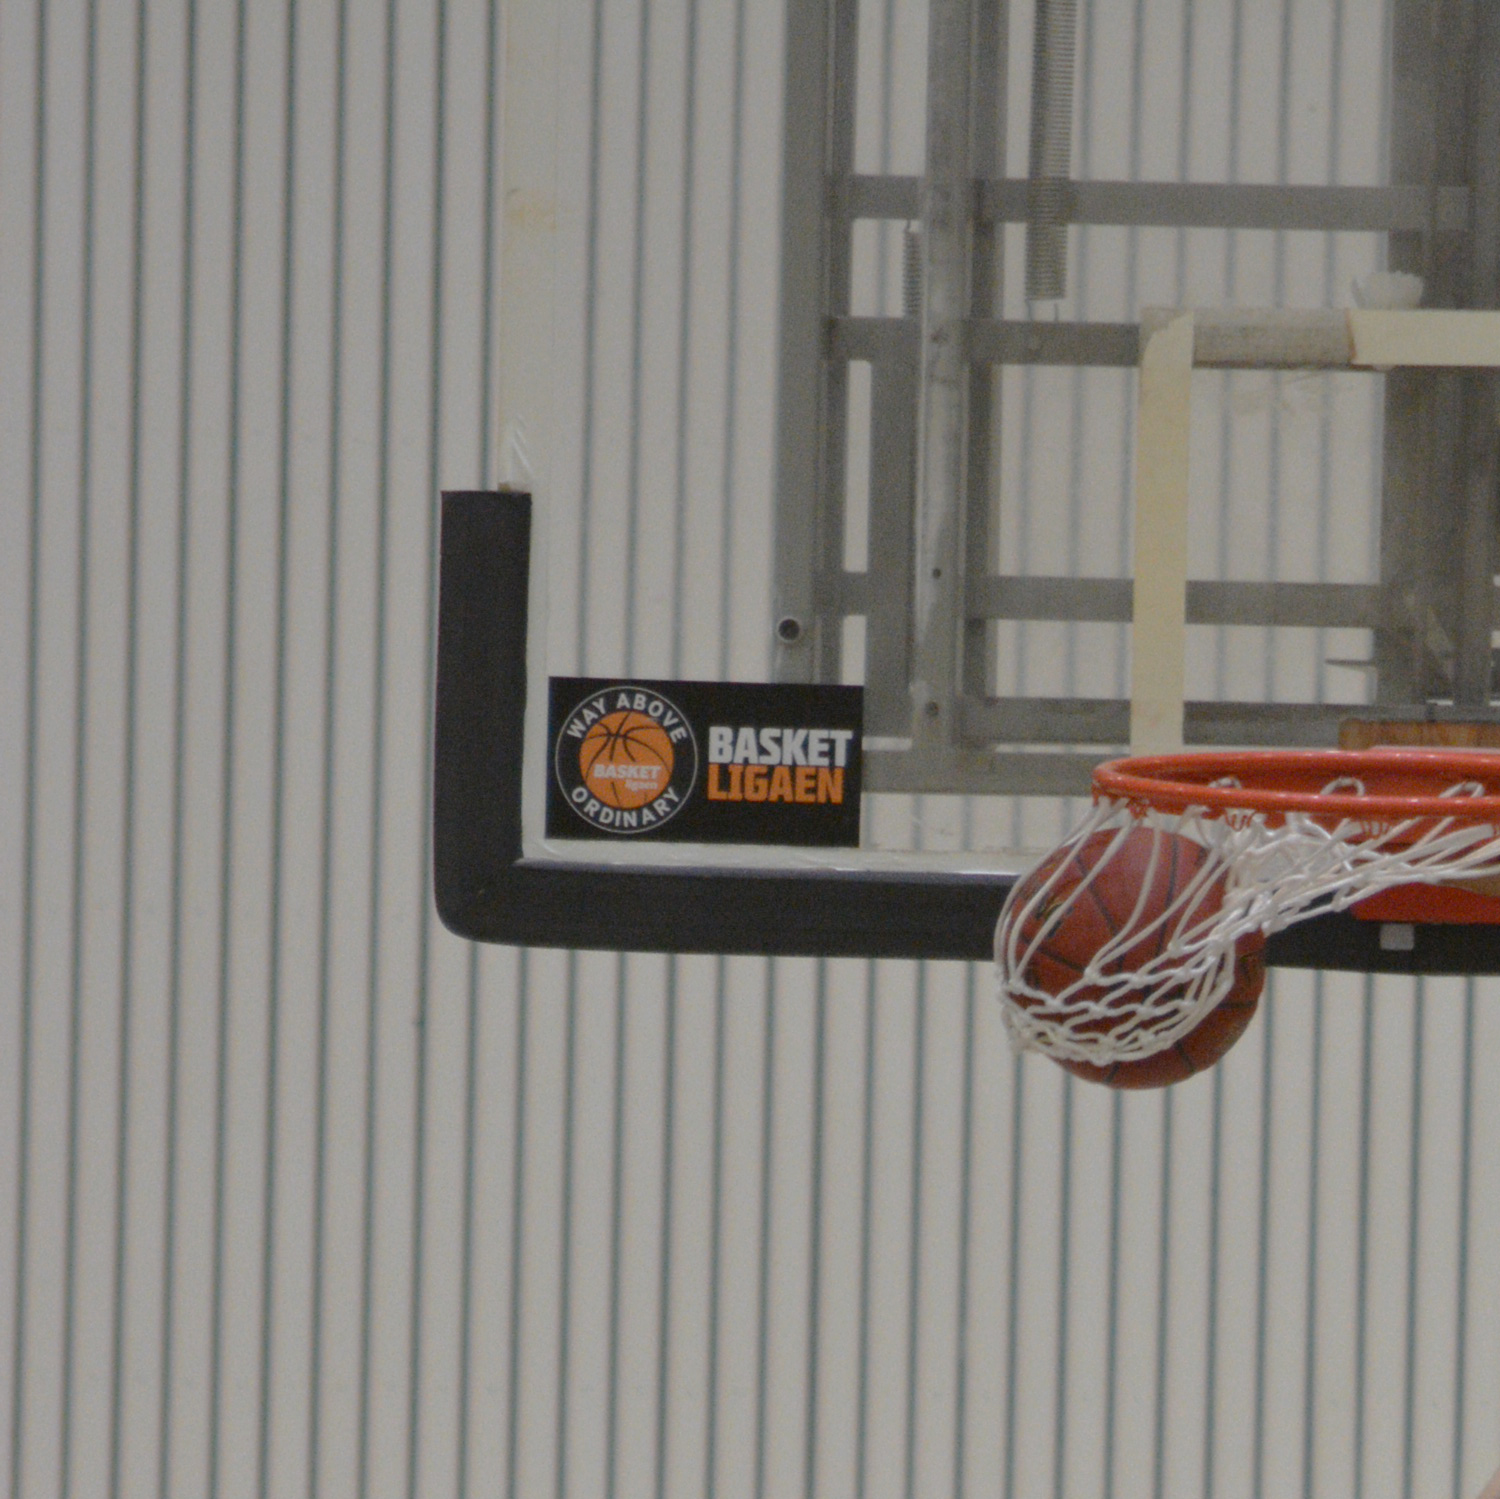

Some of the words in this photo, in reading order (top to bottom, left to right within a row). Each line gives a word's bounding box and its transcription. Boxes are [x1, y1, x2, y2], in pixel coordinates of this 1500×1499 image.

[567, 698, 607, 739] WAY
[617, 692, 688, 743] ABOVE
[709, 725, 853, 767] BASKET
[593, 764, 661, 779] BASKET
[707, 763, 844, 804] LIGAEN
[571, 786, 679, 828] ORDINARY
